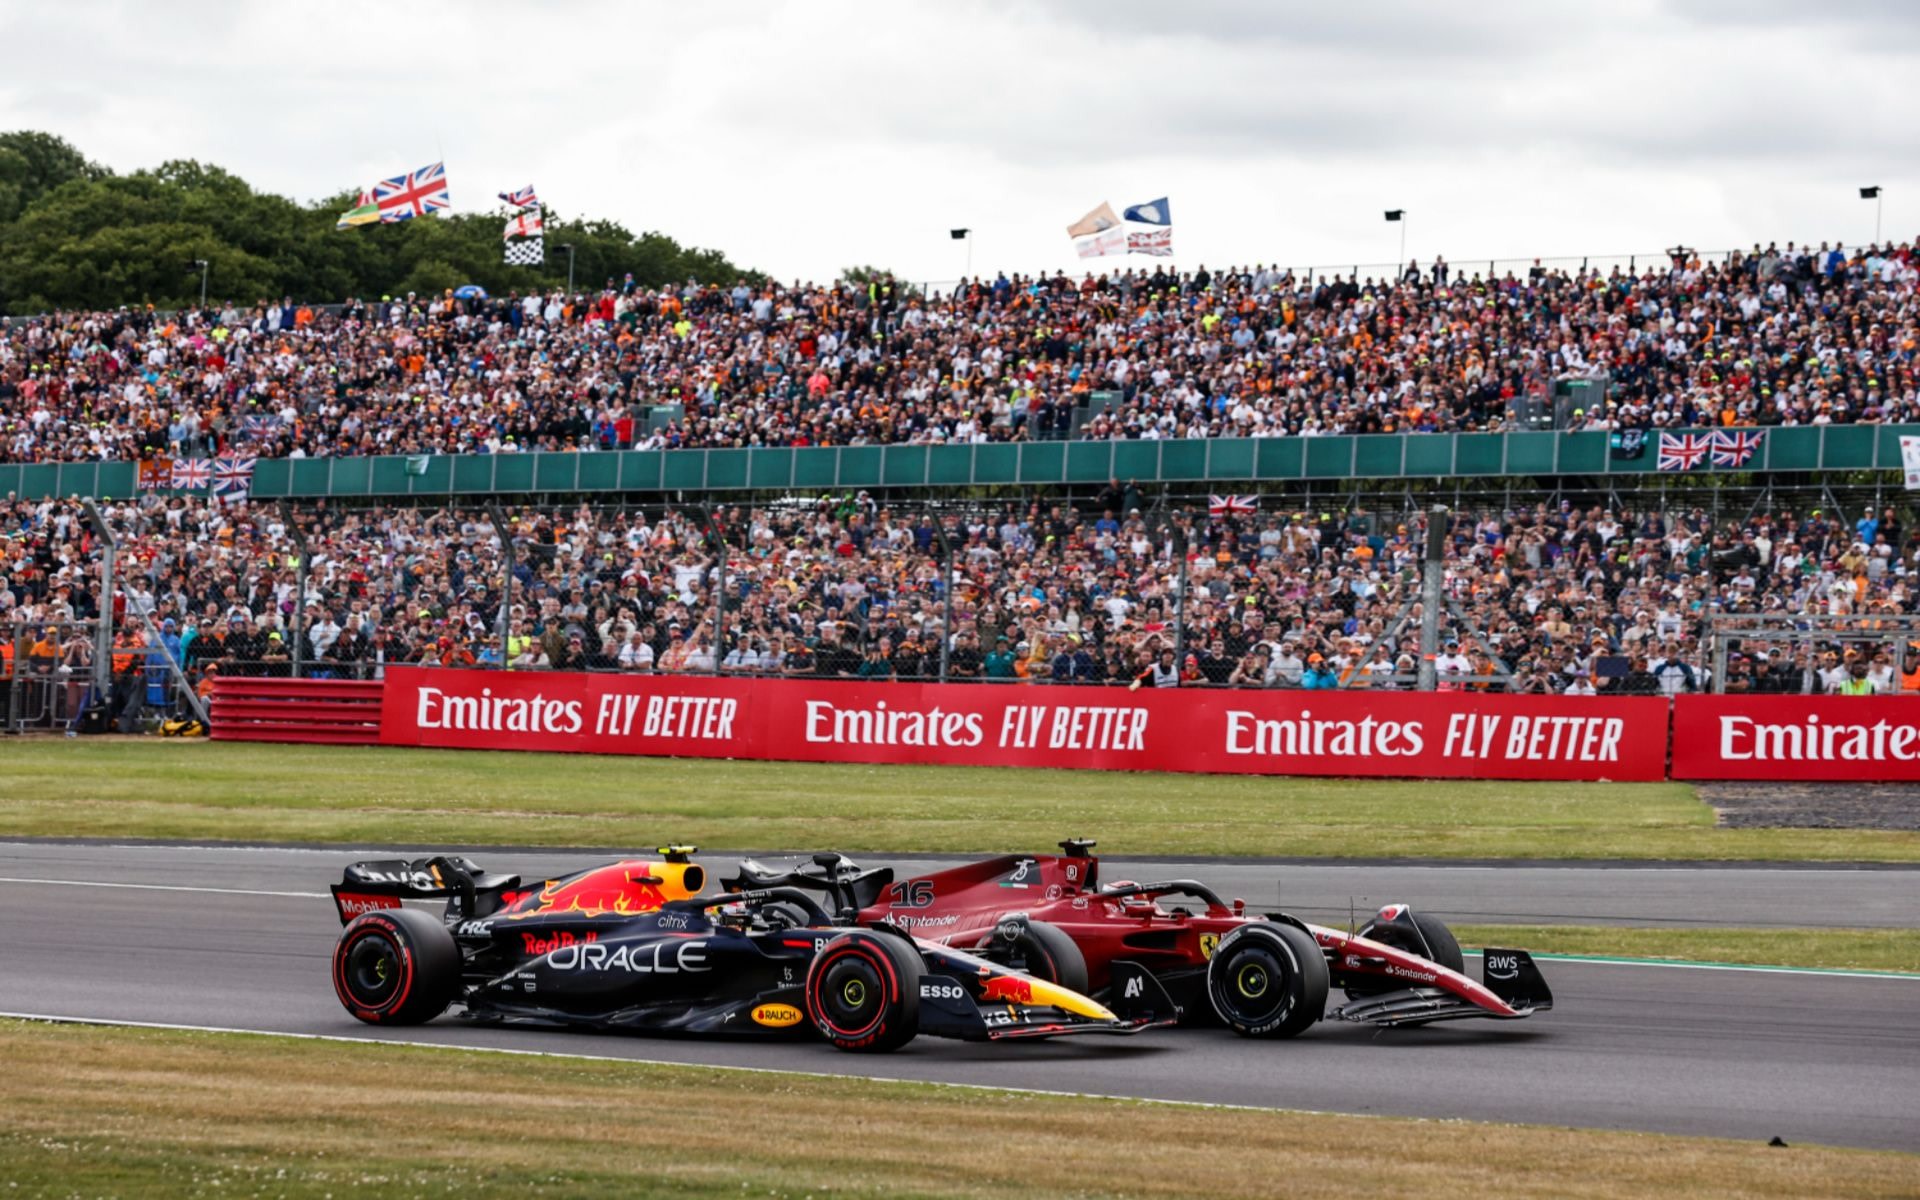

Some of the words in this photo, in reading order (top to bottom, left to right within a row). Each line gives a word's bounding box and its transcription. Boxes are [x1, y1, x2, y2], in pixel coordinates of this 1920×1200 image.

[417, 687, 582, 733] Emirates
[595, 693, 641, 736] FLY
[643, 695, 737, 739] BETTER
[806, 700, 983, 747] Emirates
[999, 705, 1047, 748] FLY
[1049, 706, 1149, 750] BETTER
[1226, 710, 1424, 756] Emirates
[1443, 713, 1501, 759] FLY
[1505, 715, 1624, 761] BETTER
[1719, 714, 1920, 760] Emirate
[889, 880, 935, 908] 16
[340, 899, 380, 914] Mobil
[458, 920, 495, 935] HRC
[899, 914, 961, 927] Santander
[521, 931, 559, 955] Red
[560, 931, 598, 949] Bll
[547, 942, 712, 973] ORACLE
[1488, 956, 1518, 969] aws
[1394, 966, 1438, 982] Santander
[920, 985, 963, 998] ESSO
[1124, 975, 1143, 998] A1
[765, 1010, 797, 1020] RAUCH
